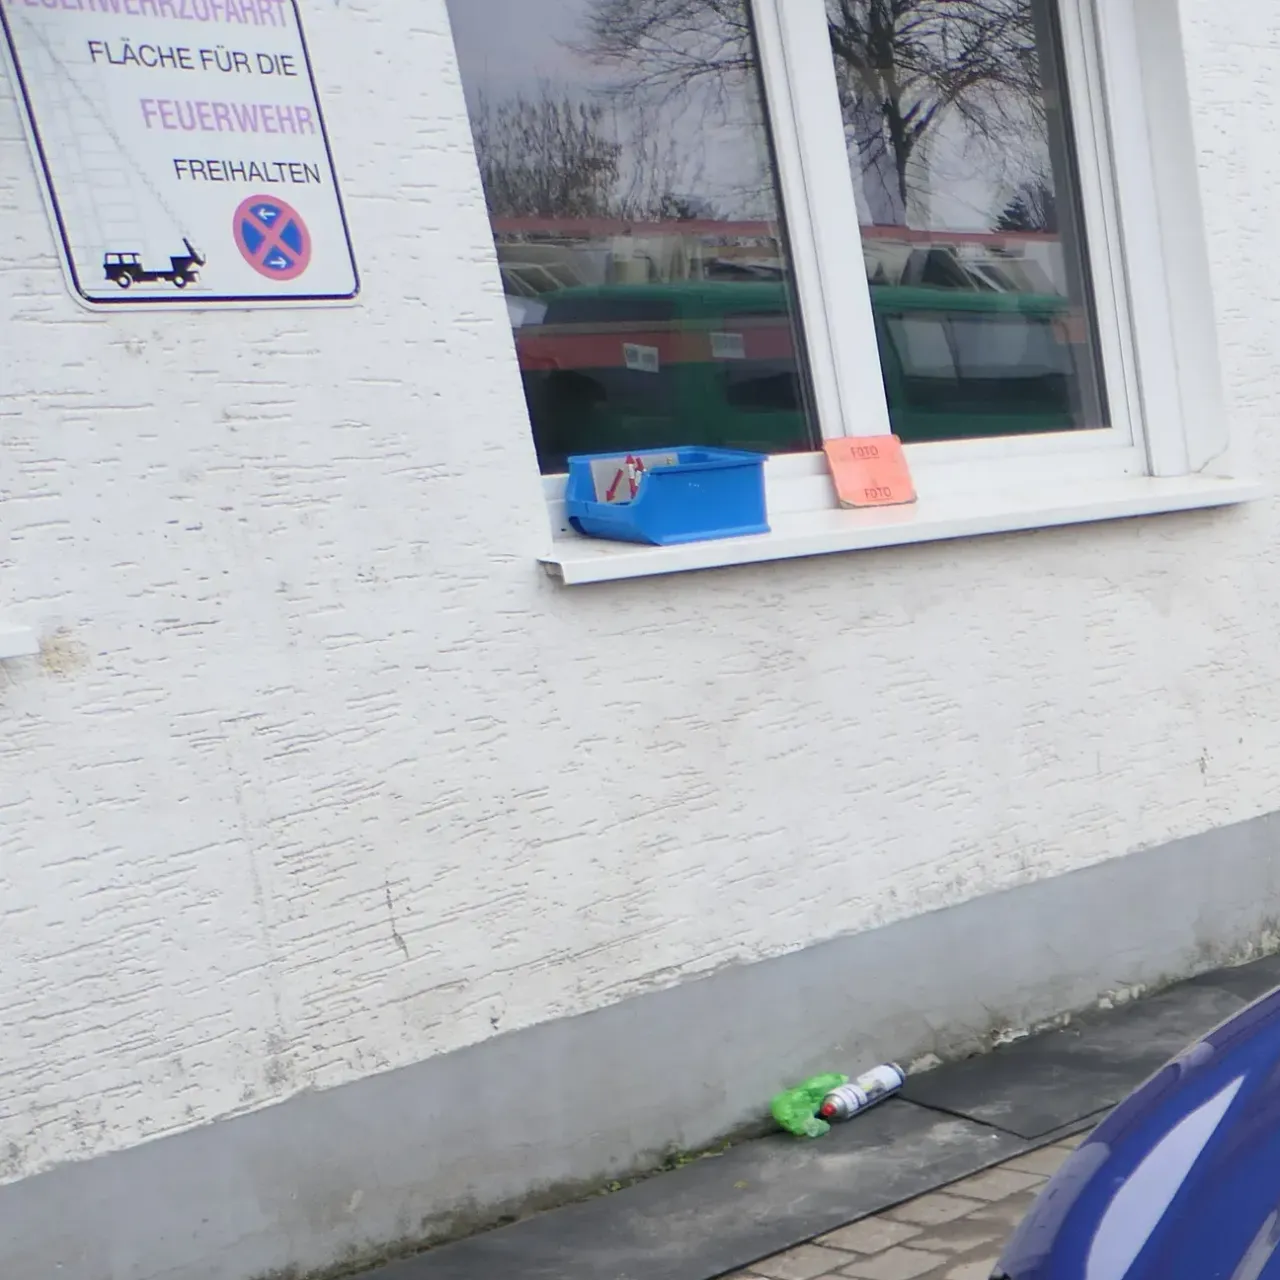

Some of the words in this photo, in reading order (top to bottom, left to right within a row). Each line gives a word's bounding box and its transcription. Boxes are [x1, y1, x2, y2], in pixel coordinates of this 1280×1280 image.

[8, 0, 288, 27] HRZUFAHRT
[87, 37, 195, 70] FLÄCHE
[199, 45, 252, 74] FÜR
[256, 53, 298, 77] DIE
[139, 98, 316, 135] FEUERWEHR
[173, 158, 322, 184] FREIHALTEN
[850, 445, 879, 458] FOTO
[864, 487, 892, 499] FOTO
